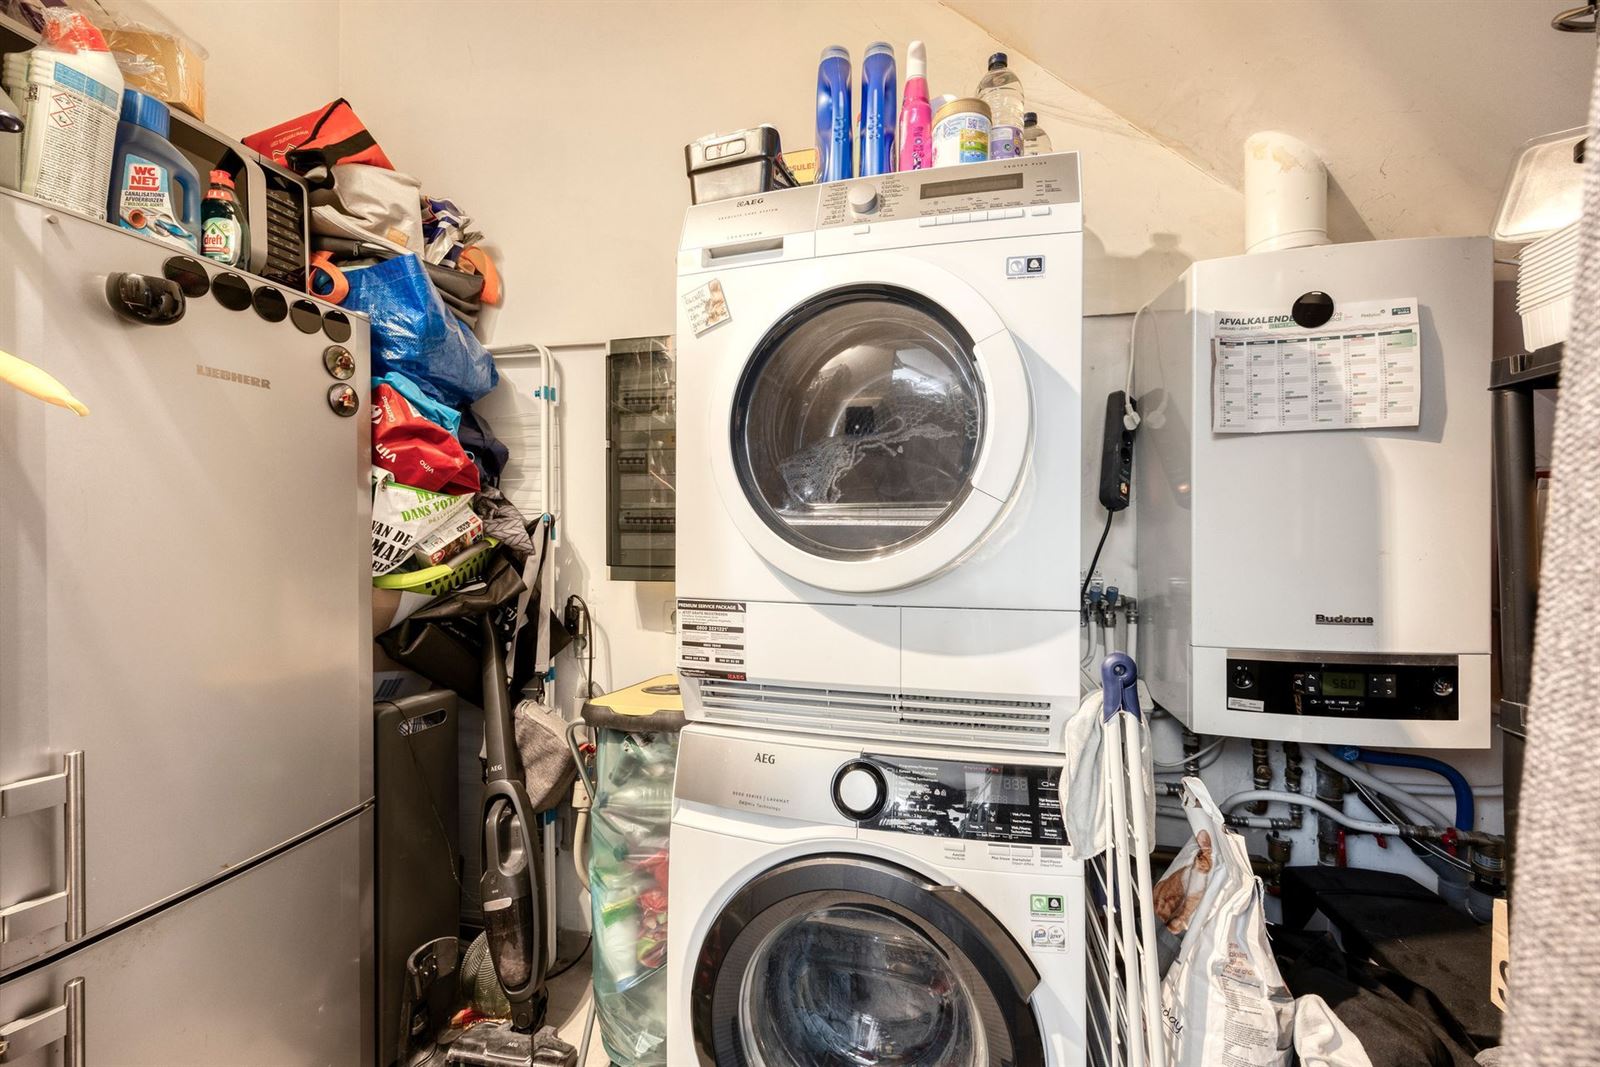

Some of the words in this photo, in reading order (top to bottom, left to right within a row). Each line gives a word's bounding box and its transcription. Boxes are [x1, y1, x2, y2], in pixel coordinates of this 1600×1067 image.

[134, 166, 156, 176] WC
[131, 175, 159, 186] NET
[743, 198, 764, 207] AEG
[204, 234, 223, 245] dreft
[1220, 315, 1296, 325] AFVALKALENDE
[196, 363, 271, 390] LIEBHERR
[376, 443, 397, 463] vin
[419, 459, 435, 474] vino
[401, 504, 432, 522] DANS
[372, 520, 391, 538] VAN
[393, 530, 413, 546] DE
[1315, 614, 1374, 624] Buderus
[754, 752, 776, 764] AEG
[491, 764, 503, 772] AEG
[1161, 1003, 1183, 1034] day
